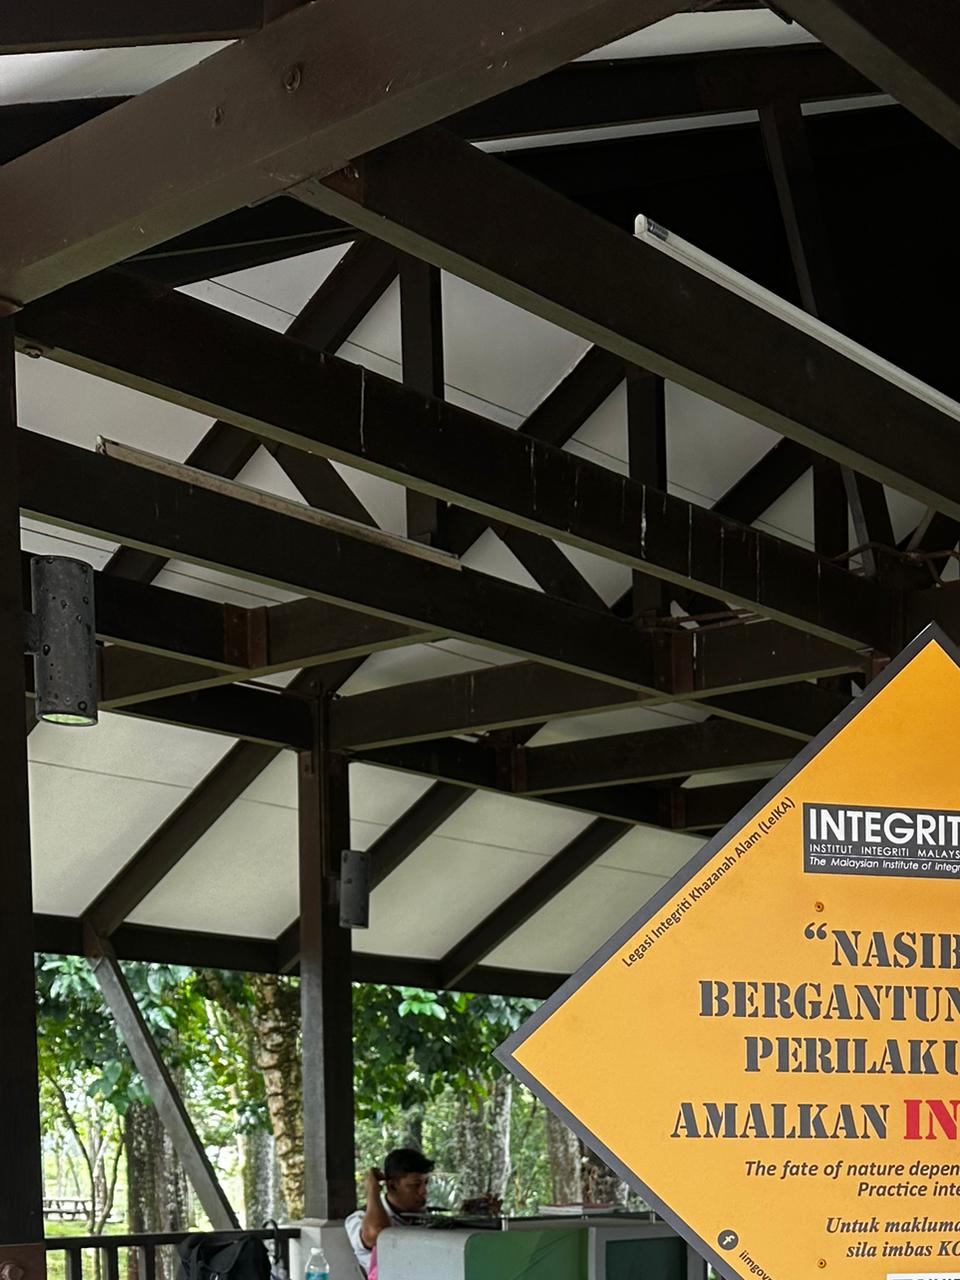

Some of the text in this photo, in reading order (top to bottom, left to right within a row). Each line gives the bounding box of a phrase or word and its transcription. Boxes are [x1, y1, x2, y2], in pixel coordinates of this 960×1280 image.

[809, 844, 852, 854] INSTITUT
[861, 846, 909, 856] INTEGRITI
[809, 857, 826, 866] The
[830, 858, 879, 869] Malaysian
[883, 858, 918, 870] Institute
[922, 862, 932, 870] of
[622, 797, 796, 967] Legasi Integriti Khazanah Alam (LeIKA)
[670, 1102, 890, 1140] AMALKAN
[745, 1160, 777, 1176] The
[780, 1160, 819, 1180] fate
[823, 1160, 844, 1180] of
[846, 1162, 905, 1176] nature
[857, 1181, 928, 1197] Practice
[825, 1217, 880, 1234] Untuk
[846, 1241, 877, 1258] sila
[882, 1241, 933, 1257] imbas
